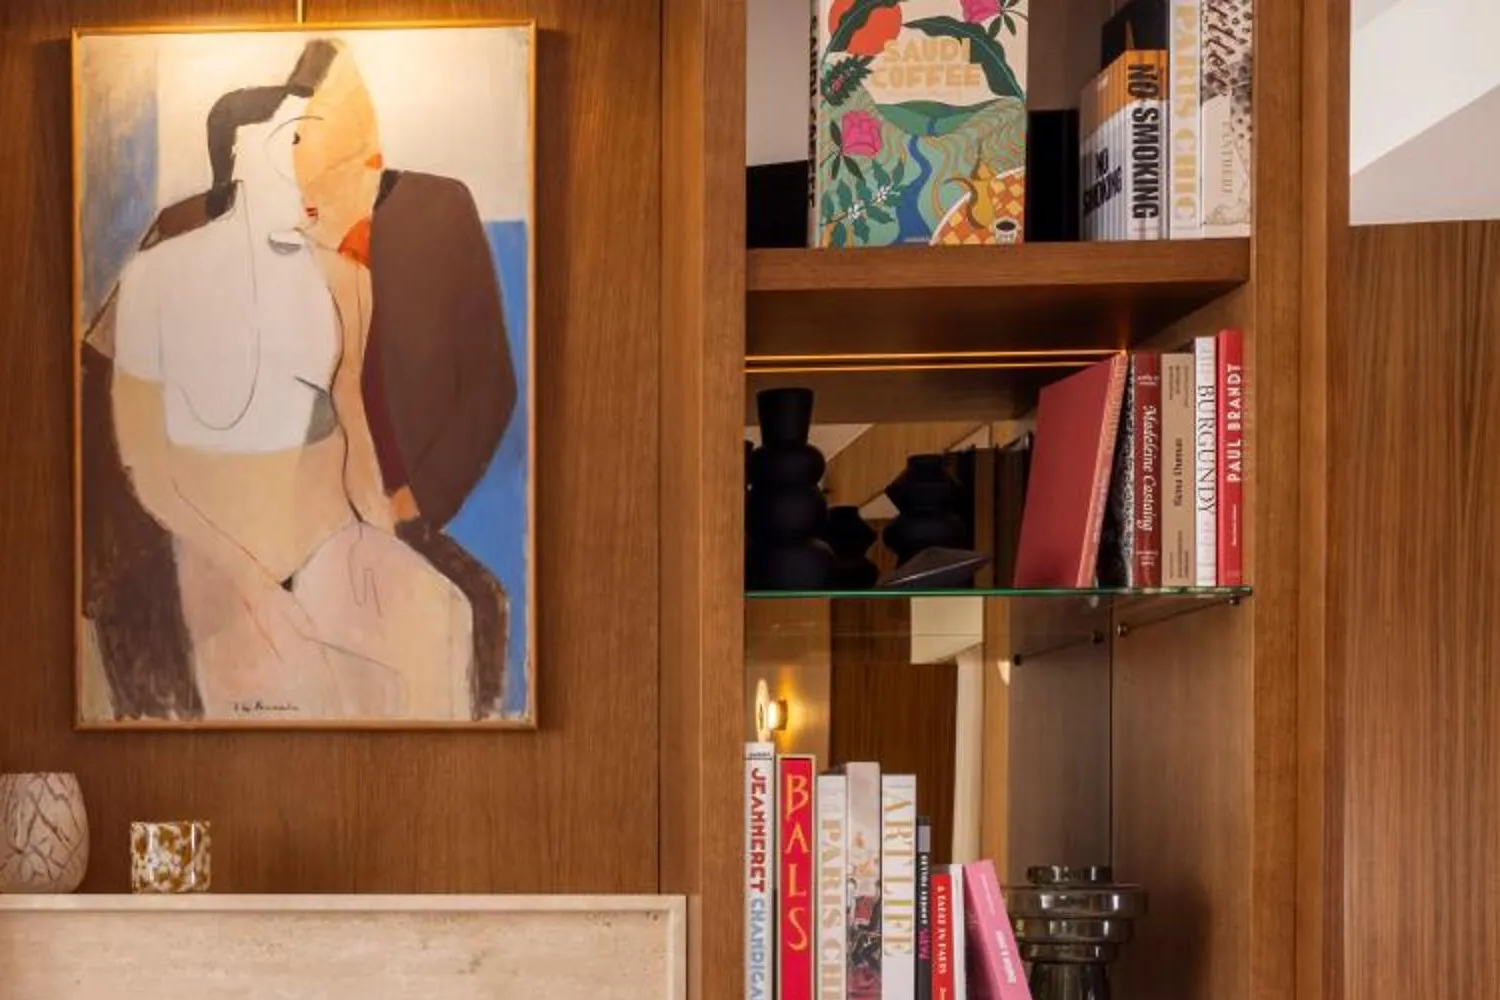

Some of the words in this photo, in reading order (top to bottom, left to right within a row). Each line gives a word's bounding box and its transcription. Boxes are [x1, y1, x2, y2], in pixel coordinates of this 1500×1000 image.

[870, 63, 981, 91] COFFEE
[883, 37, 971, 65] SAUDI
[1127, 64, 1161, 100] NO
[1174, 3, 1198, 120] PARIS
[1132, 106, 1160, 221] SMOKING
[1174, 128, 1198, 221] CHIC
[1227, 363, 1242, 431] BRANDT
[1198, 385, 1215, 513] BURGUNDY
[1227, 440, 1242, 483] PAUL
[750, 767, 767, 893] JEANNERET
[785, 773, 810, 951] BALS
[821, 819, 842, 930] PARIS
